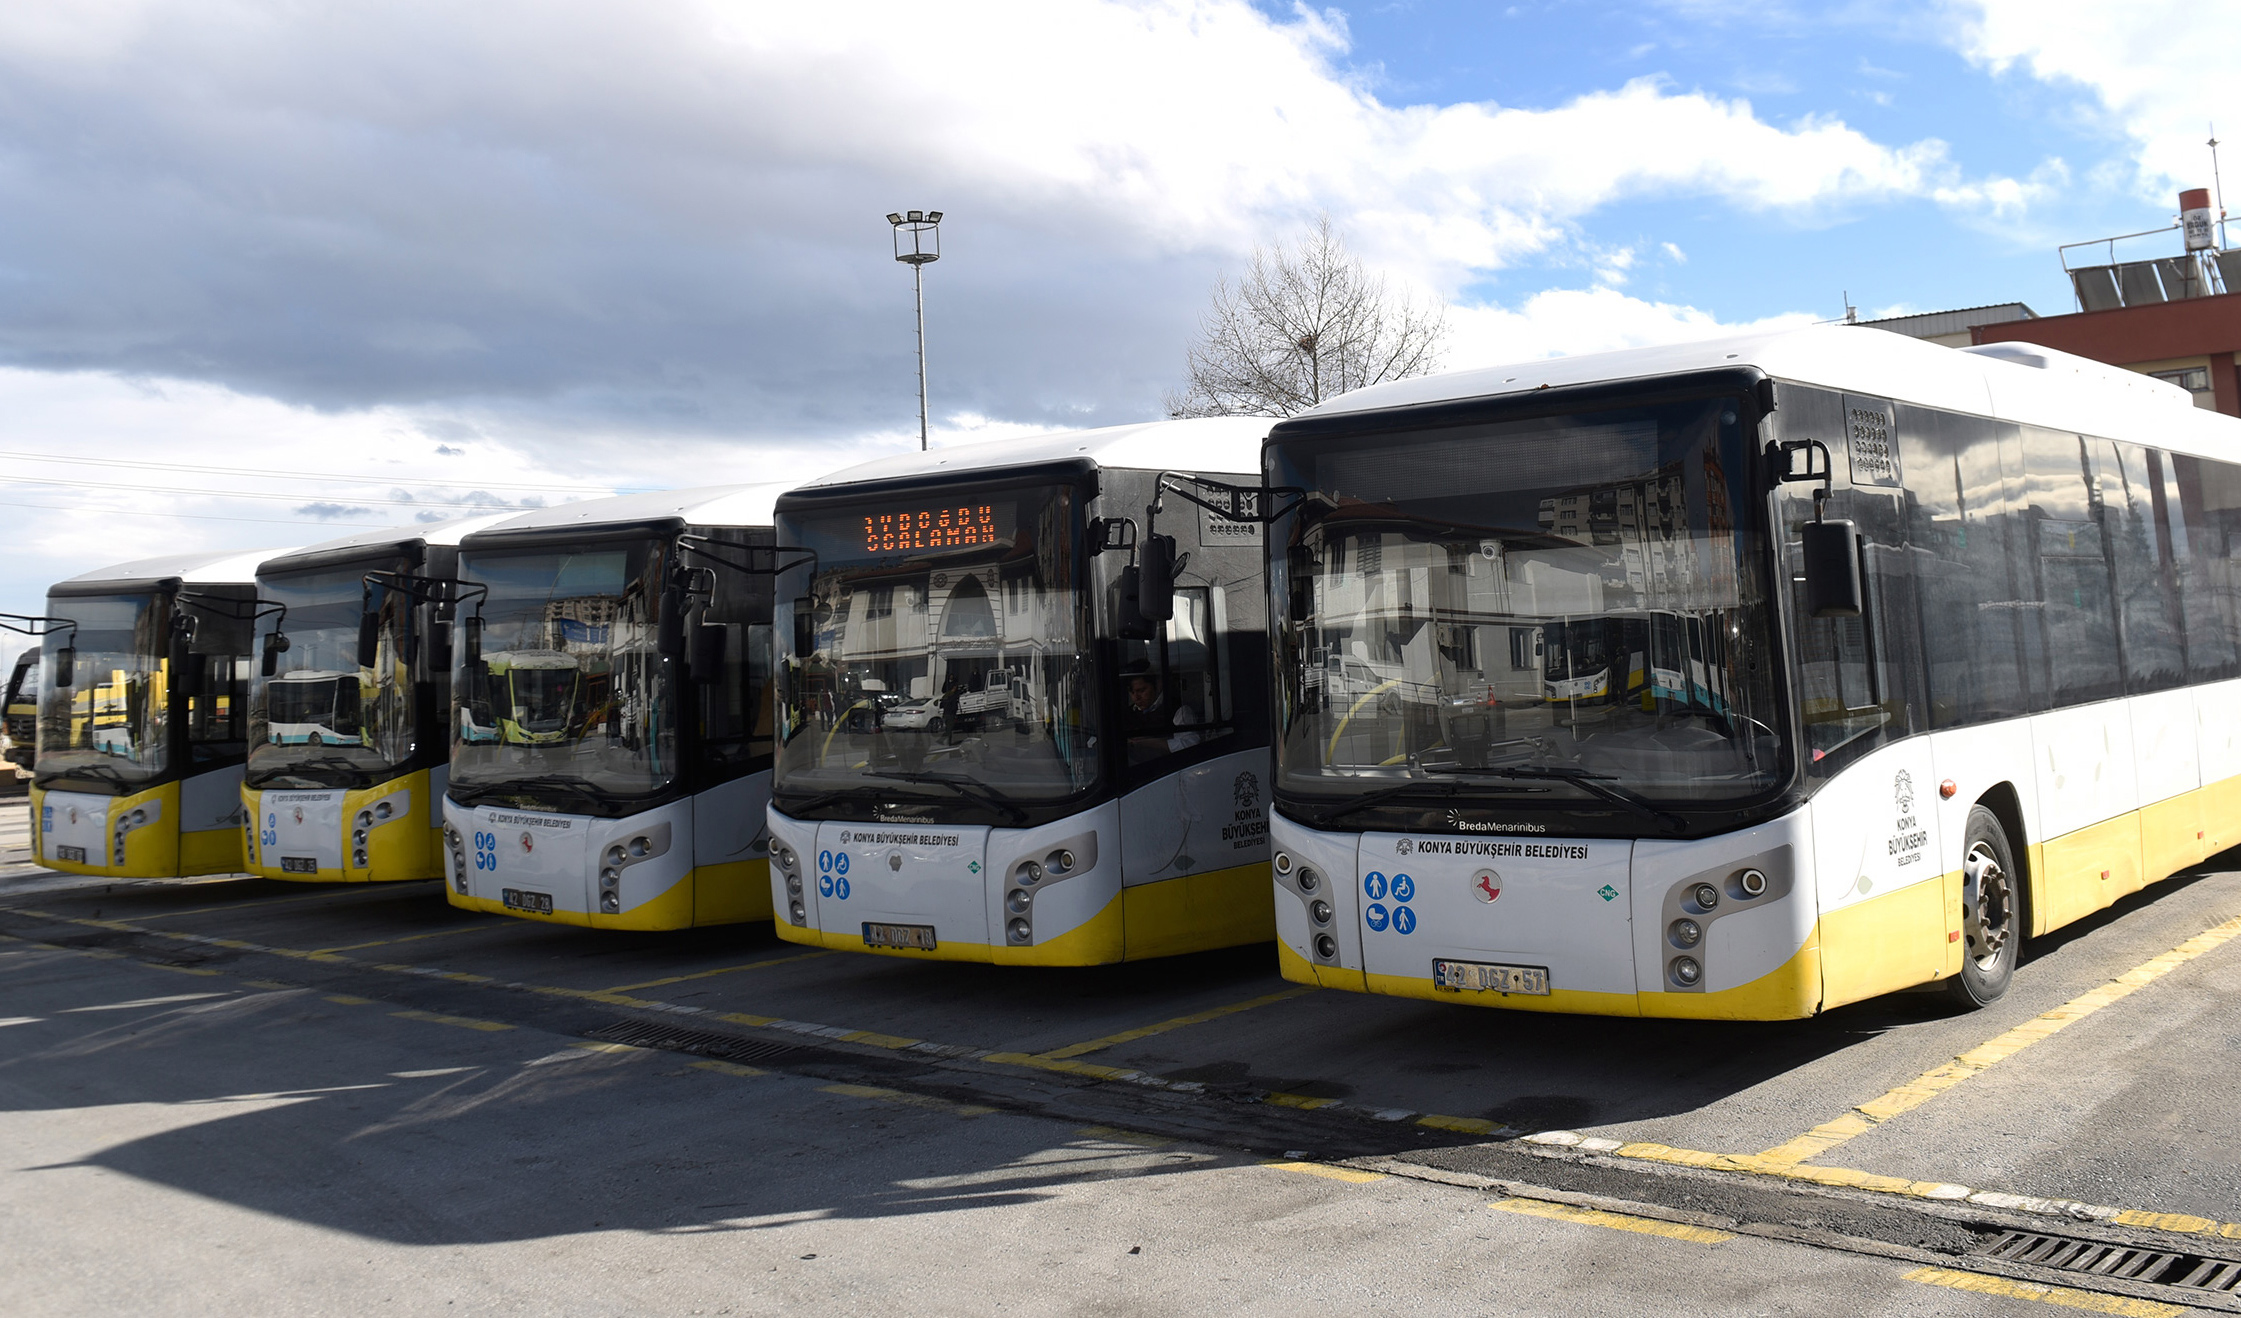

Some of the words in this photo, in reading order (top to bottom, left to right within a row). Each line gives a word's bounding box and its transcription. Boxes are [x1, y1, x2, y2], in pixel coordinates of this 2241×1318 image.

[1234, 808, 1261, 822] KONYA
[1222, 817, 1270, 841] BÜYÜKŞEHİ
[1459, 821, 1545, 833] BredaMenarinibus
[1897, 816, 1916, 831] KONYA
[853, 832, 875, 843] KONYA
[876, 832, 918, 847] BÜYÜKŞEHİR
[919, 833, 959, 847] BELEDİYESİ
[1234, 836, 1265, 849] BELEDİYESİ
[1418, 841, 1451, 854] KONYA
[1455, 840, 1522, 859] BÜYÜKŞEHİR
[1525, 844, 1588, 859] BELEDİYESİ
[1600, 888, 1615, 898] CNG
[1446, 964, 1466, 986] 42
[1478, 967, 1510, 990] DGZ
[1522, 970, 1543, 992] 57
